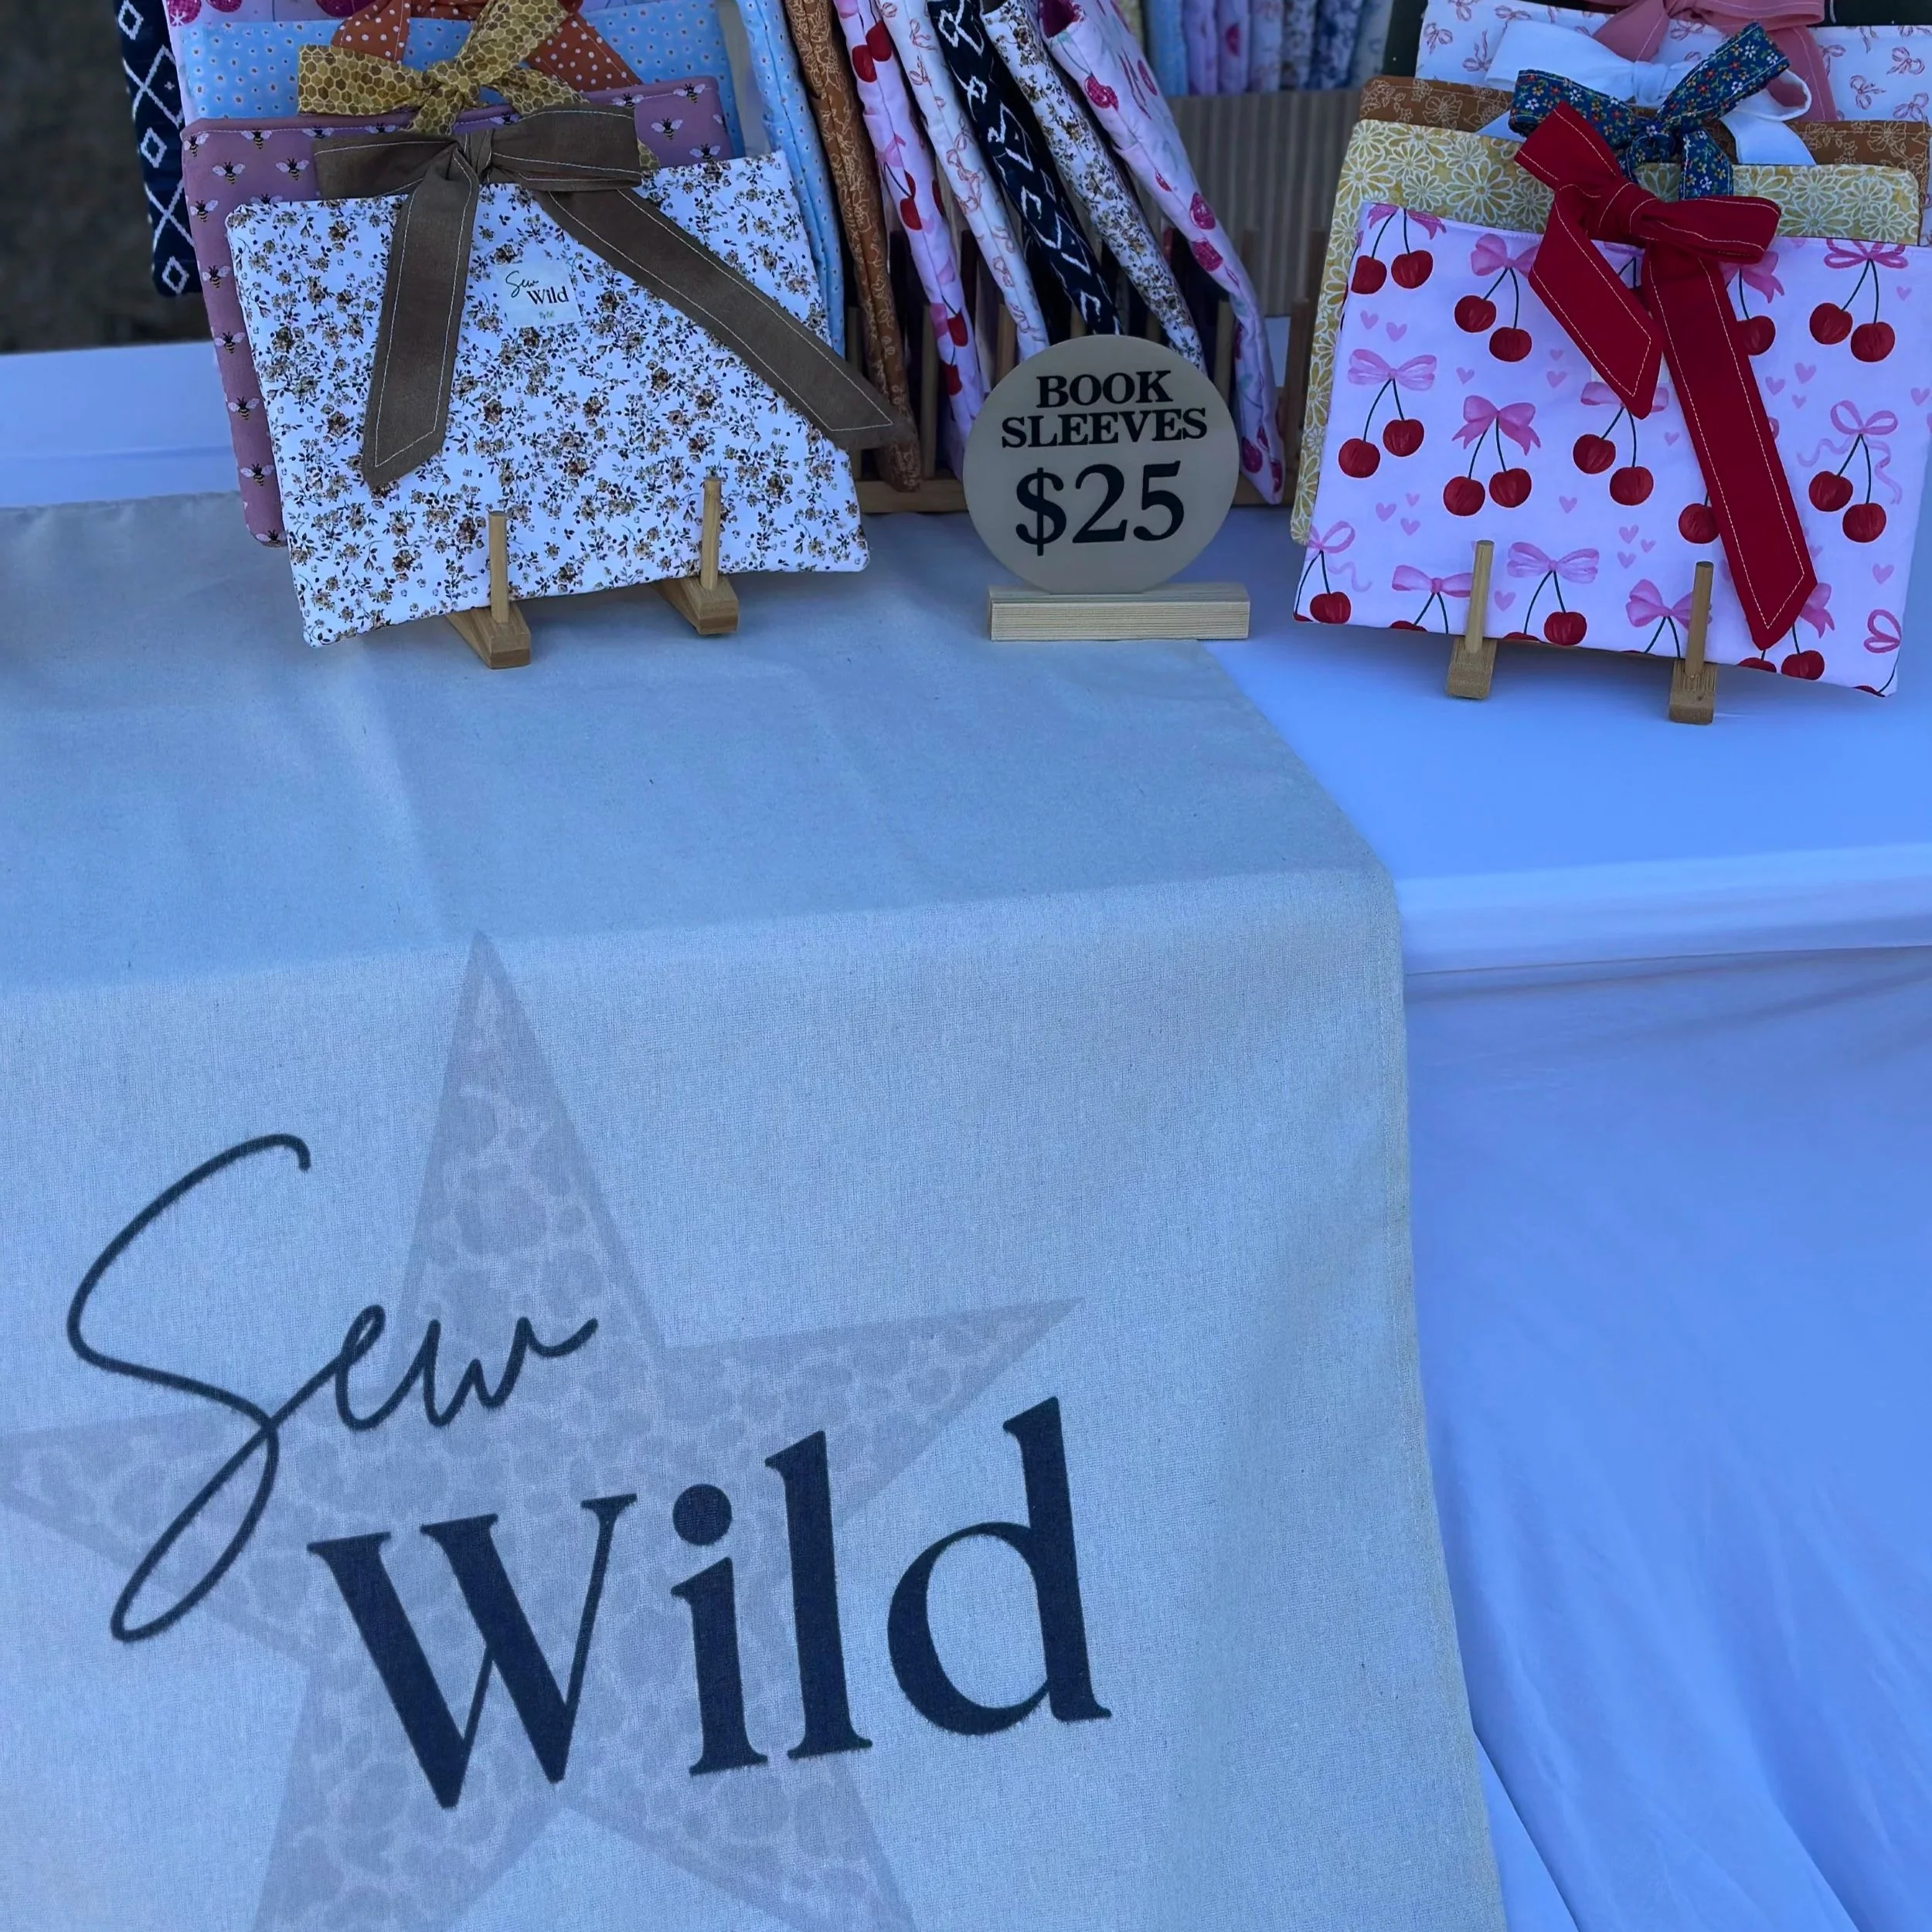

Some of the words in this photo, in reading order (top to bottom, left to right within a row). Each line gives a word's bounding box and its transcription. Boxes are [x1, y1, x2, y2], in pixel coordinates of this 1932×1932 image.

[505, 270, 539, 298] Sew
[527, 286, 569, 304] Wild
[1036, 370, 1173, 408] BOOK
[1002, 407, 1207, 448] SLEEVES
[1015, 461, 1184, 556] $25
[67, 1134, 598, 1642] Sew
[308, 1396, 1111, 1808] Wild
